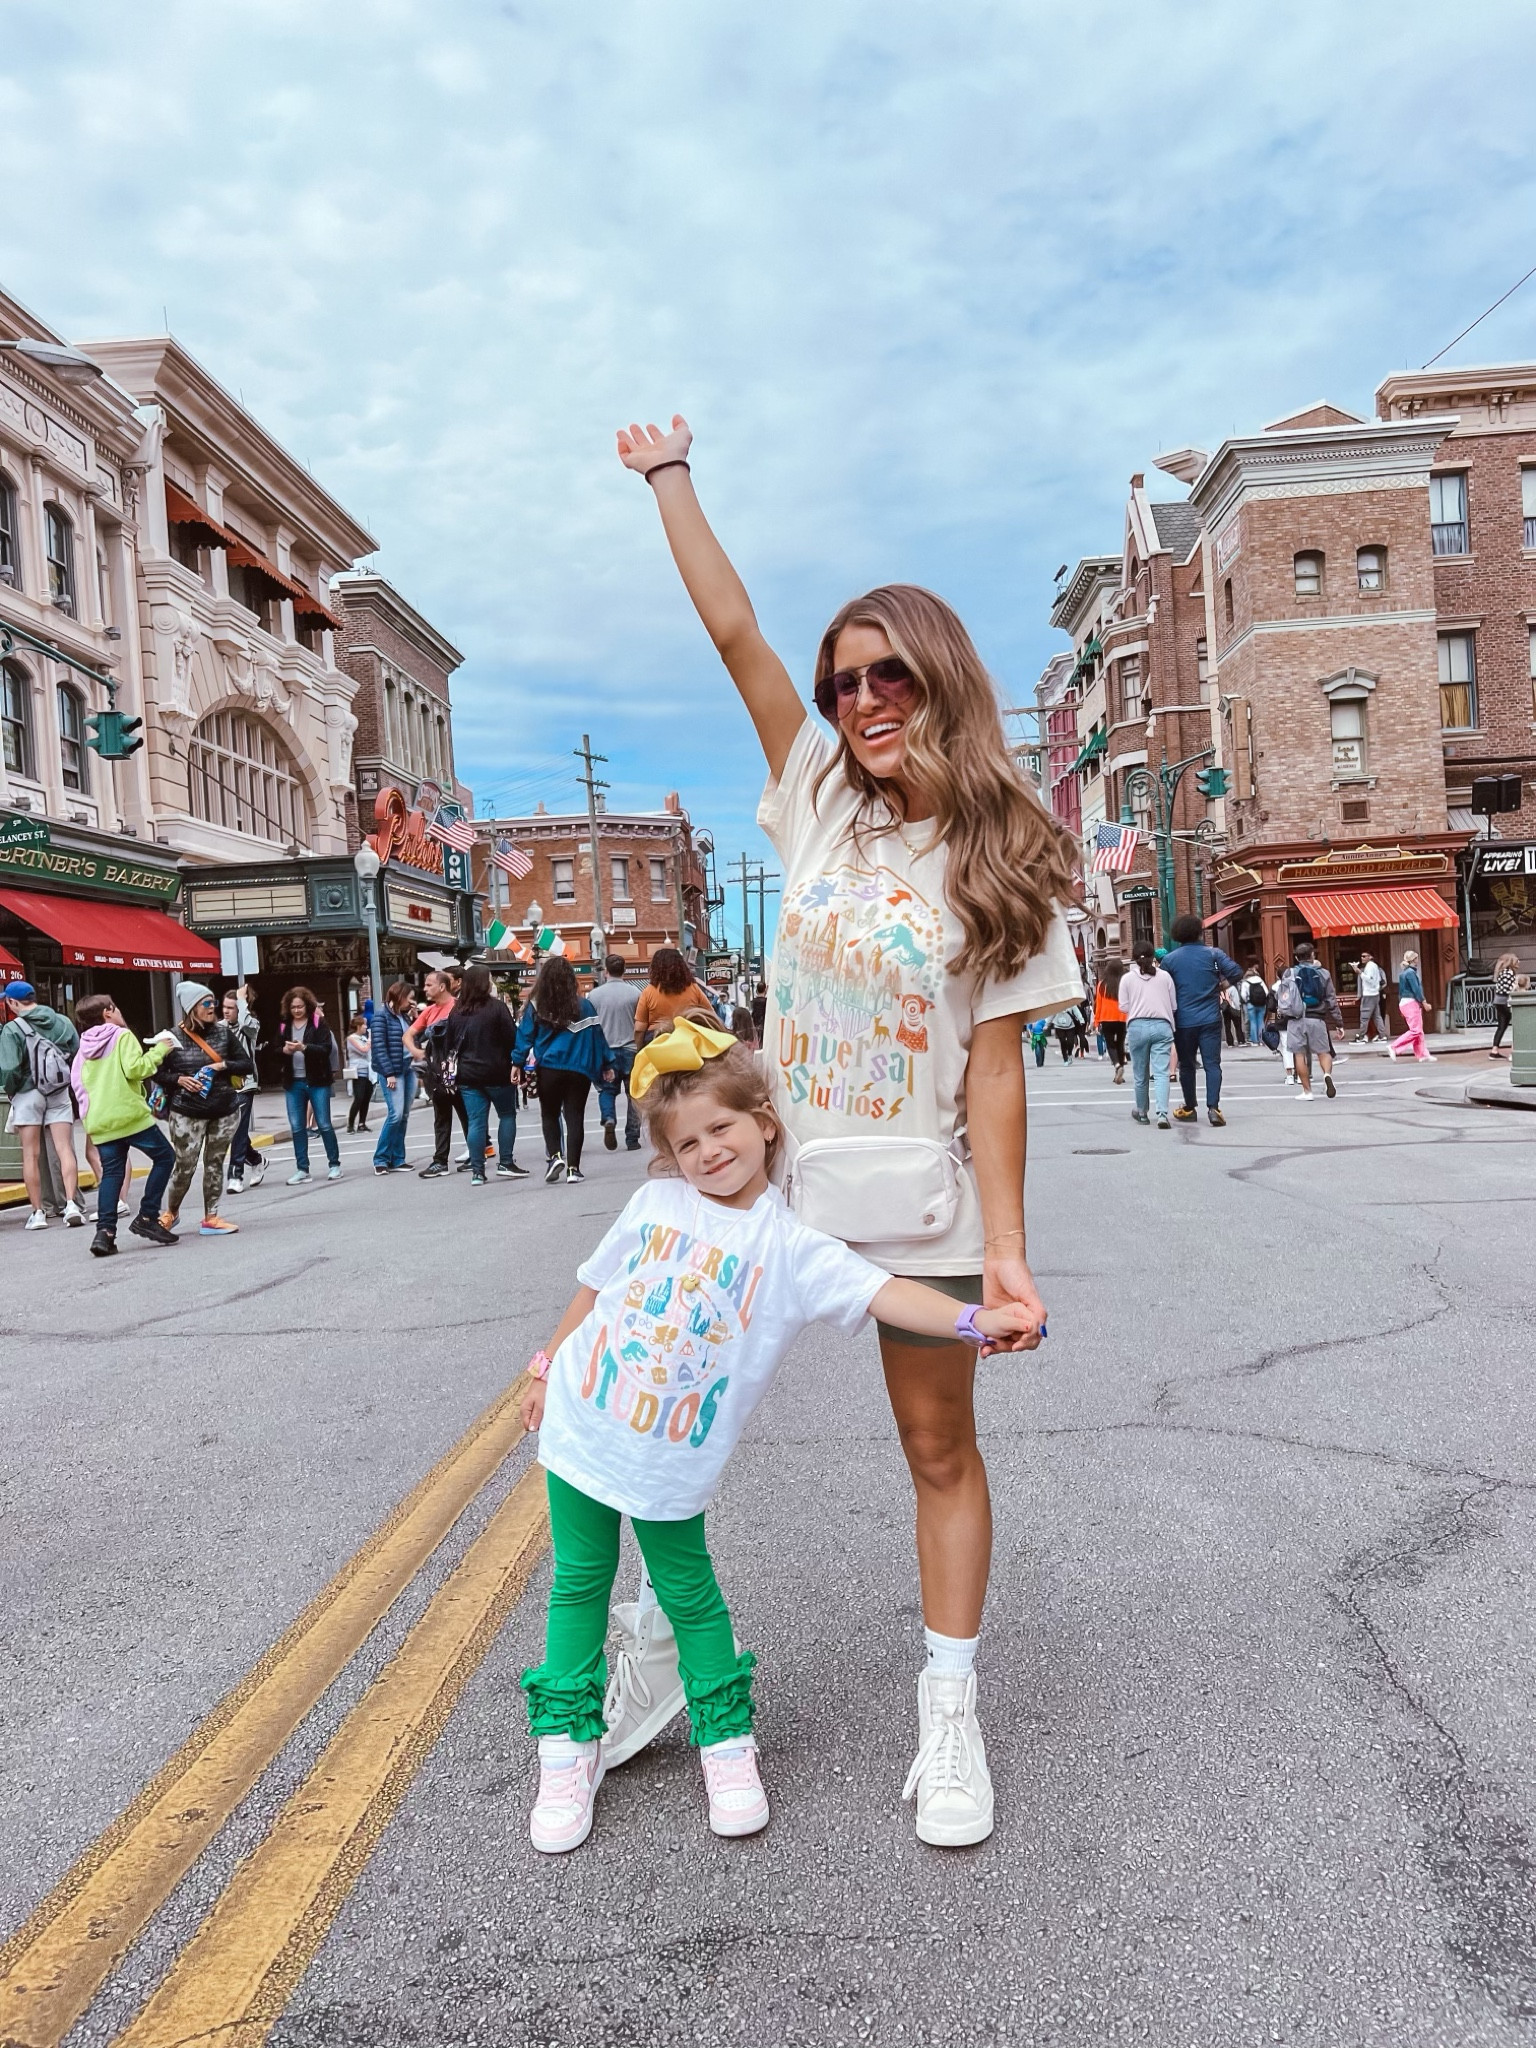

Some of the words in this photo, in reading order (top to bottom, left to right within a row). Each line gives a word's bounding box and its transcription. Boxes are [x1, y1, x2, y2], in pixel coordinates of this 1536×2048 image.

[34, 830, 47, 840] ST.
[1483, 850, 1523, 859] APPEARING
[1484, 858, 1521, 872] LIVE!
[103, 864, 175, 892] BAKERY
[1295, 863, 1374, 878] HAND-ROLLED
[1377, 859, 1430, 872] PRETZELS
[11, 971, 23, 980] 206
[779, 1018, 914, 1099] Universal
[791, 1064, 886, 1120] Studios
[628, 1222, 764, 1334] UNIVERSAL
[581, 1324, 729, 1449] STUDIOS
